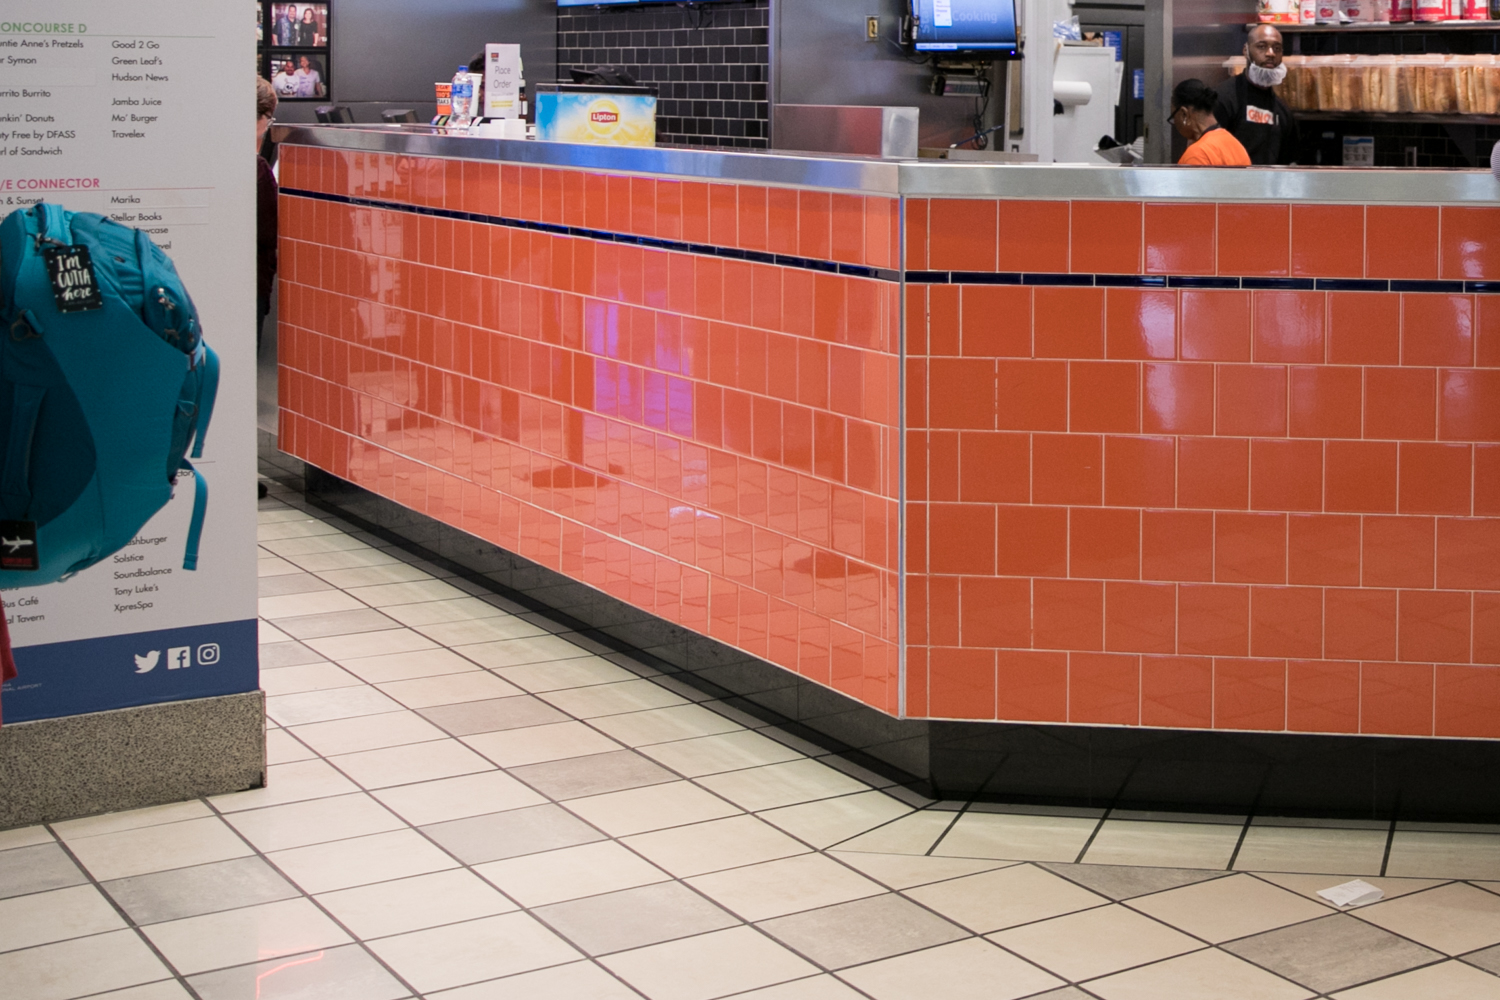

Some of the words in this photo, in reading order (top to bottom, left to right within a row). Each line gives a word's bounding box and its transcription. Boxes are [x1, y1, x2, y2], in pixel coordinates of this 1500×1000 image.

[78, 23, 87, 33] D
[0, 39, 18, 47] ntie
[20, 39, 49, 48] Anne's
[52, 39, 84, 48] Pretzels
[111, 40, 136, 49] Good
[138, 40, 144, 49] 2
[146, 40, 160, 49] Go
[7, 55, 37, 67] Symon
[111, 56, 138, 65] Green
[140, 56, 163, 65] Leaf's
[111, 72, 143, 81] Hudson
[145, 73, 169, 81] News
[0, 89, 20, 97] rrito
[22, 89, 51, 98] Burrito
[111, 97, 139, 106] Jamba
[141, 97, 162, 106] Juice
[0, 114, 22, 122] nkin'
[25, 114, 55, 122] Donuts
[111, 114, 128, 122] Mo'
[131, 114, 158, 124] Burger
[591, 112, 618, 123] Lipton
[12, 130, 31, 139] Free
[33, 130, 44, 141] by
[46, 130, 76, 139] DFASS
[111, 129, 146, 138] Travelex
[9, 146, 18, 155] of
[20, 146, 63, 155] Sandwich
[16, 178, 100, 189] CONNECTOR
[6, 196, 14, 205] &
[16, 196, 44, 205] Sunset
[111, 195, 141, 204] Marika
[111, 212, 136, 221] Stellar
[138, 212, 162, 221] Books
[56, 254, 82, 271] I'm
[62, 286, 93, 300] here
[113, 553, 144, 564] Solstice
[113, 567, 173, 580] Soundbalance
[113, 587, 133, 597] Tony
[135, 583, 159, 594] Luke's
[18, 596, 39, 607] Café
[113, 600, 154, 614] XpresSpa
[16, 614, 45, 623] Tavern
